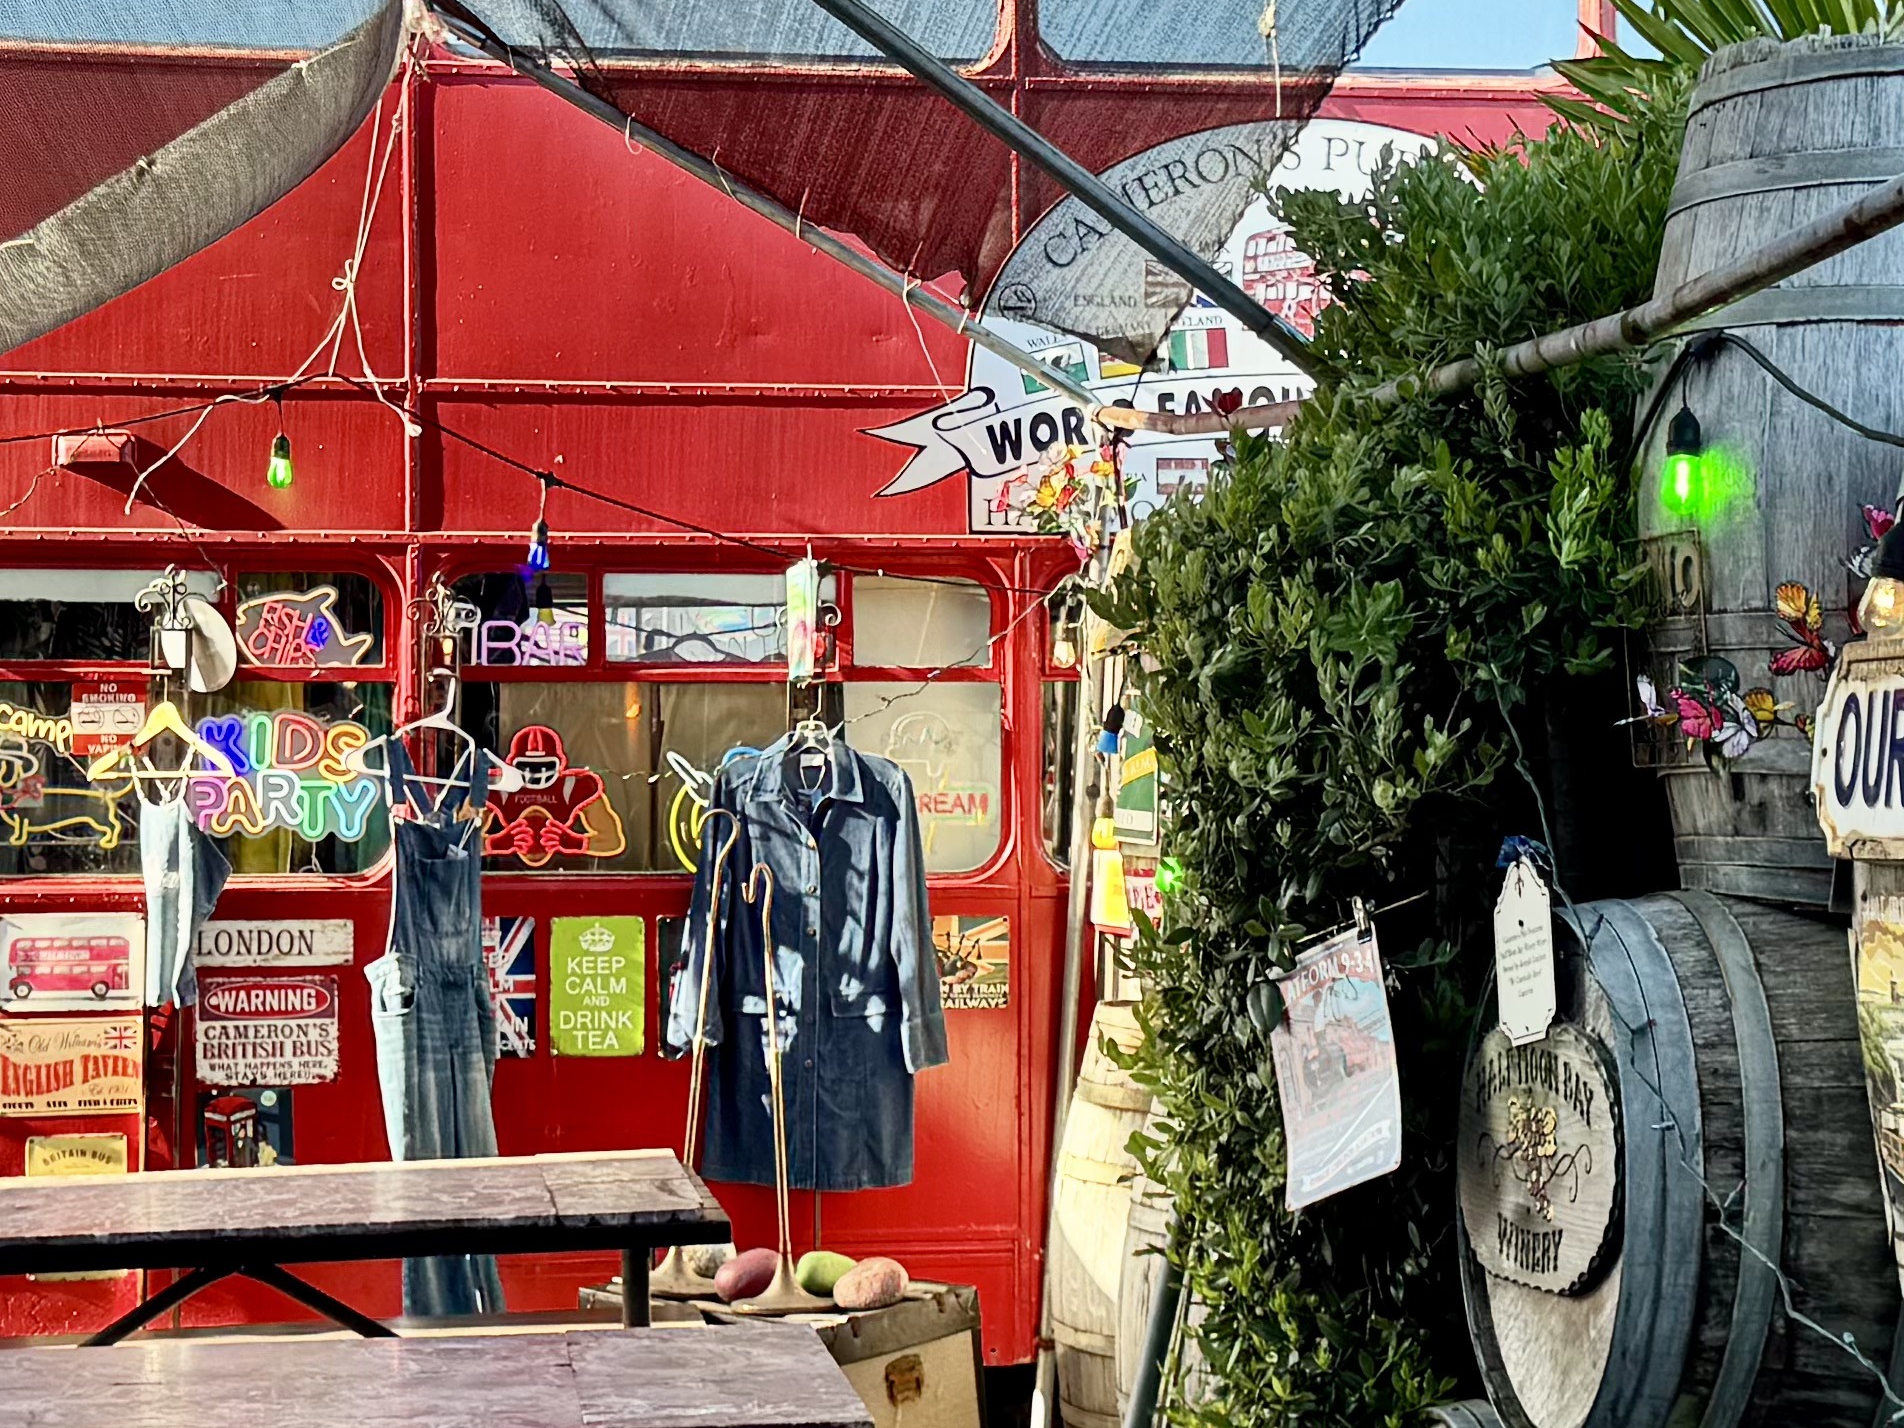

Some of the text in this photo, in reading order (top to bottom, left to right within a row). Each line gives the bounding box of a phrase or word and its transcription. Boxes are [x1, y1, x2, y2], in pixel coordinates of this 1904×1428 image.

[1074, 294, 1137, 308] ENGLAND
[1179, 316, 1223, 329] LAND
[248, 627, 318, 666] CHIPS
[481, 620, 586, 666] BAR
[100, 683, 119, 693] NO
[82, 693, 136, 703] SMOKING
[100, 734, 118, 744] NO
[200, 713, 368, 783] KIDS
[87, 744, 124, 754] VAPI
[190, 769, 376, 839] PARTY
[515, 794, 557, 803] FOOTBALL
[919, 792, 989, 817] REAM
[198, 929, 315, 957] LONDON
[567, 957, 626, 975] KEEP
[565, 976, 627, 994] CALM
[972, 983, 1008, 993] TRAIN
[1287, 954, 1340, 1006] ATFORM
[217, 988, 317, 1012] WARNING
[583, 996, 610, 1007] AND
[559, 1010, 633, 1029] DRINK
[204, 1023, 330, 1040] CAMERON'S
[572, 1031, 619, 1050] TEA
[28, 1035, 52, 1052] Old
[203, 1040, 332, 1060] BRITISH BUS
[0, 1053, 140, 1097] ENGLISH TAVERN
[209, 1062, 238, 1072] WHAT
[245, 1061, 293, 1071] HAPPENS
[225, 1072, 266, 1082] STAYS
[1516, 1046, 1560, 1095] MOON
[1563, 1060, 1594, 1129] BAY
[43, 1148, 112, 1166] BRITAIN BUS
[1497, 1211, 1563, 1275] WINERY
